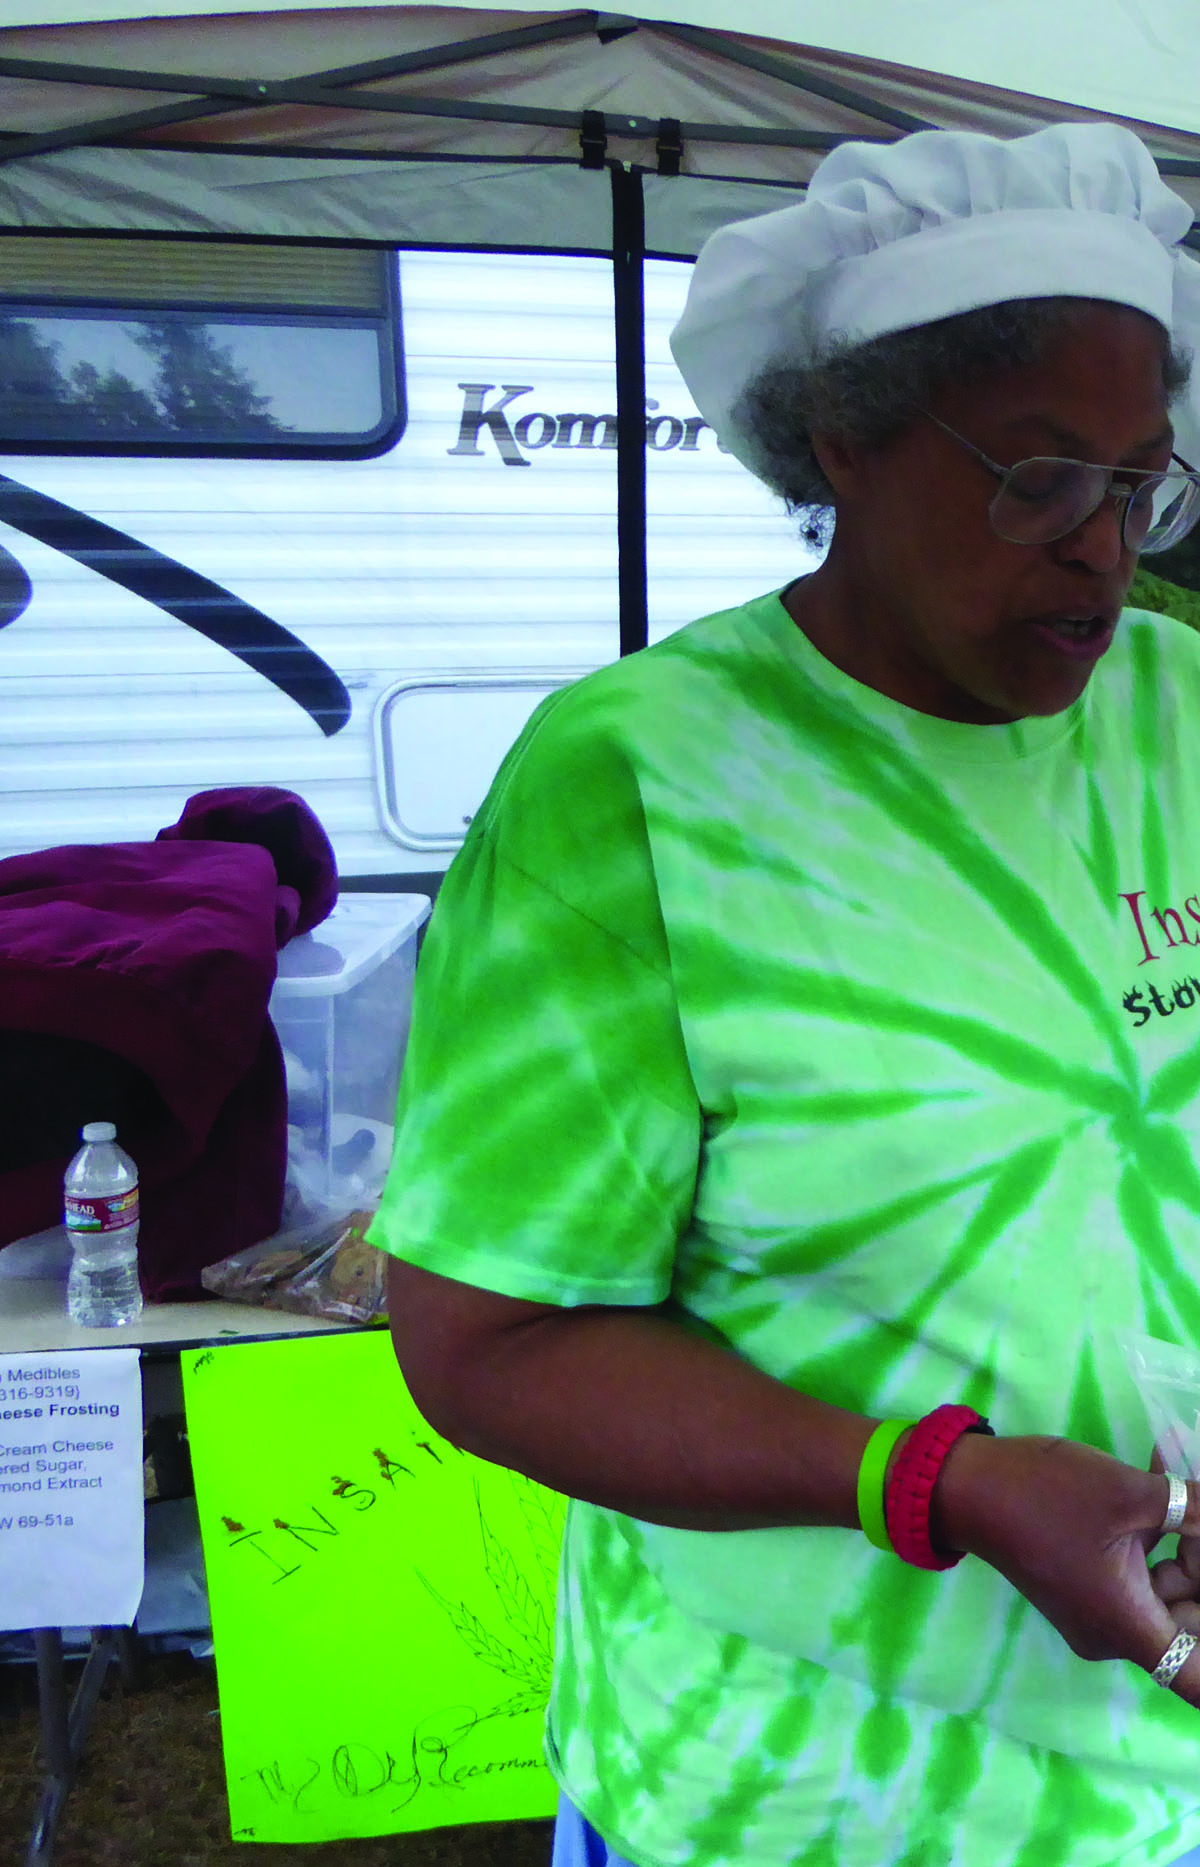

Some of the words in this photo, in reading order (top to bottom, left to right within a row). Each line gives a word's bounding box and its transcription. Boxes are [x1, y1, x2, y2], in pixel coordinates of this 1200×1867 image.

[446, 383, 734, 467] Komor
[8, 1367, 80, 1381] Medibles
[0, 1407, 43, 1420] eese
[49, 1403, 120, 1418] Frosting
[52, 1440, 114, 1453] Cheese
[48, 1477, 103, 1490] Extract
